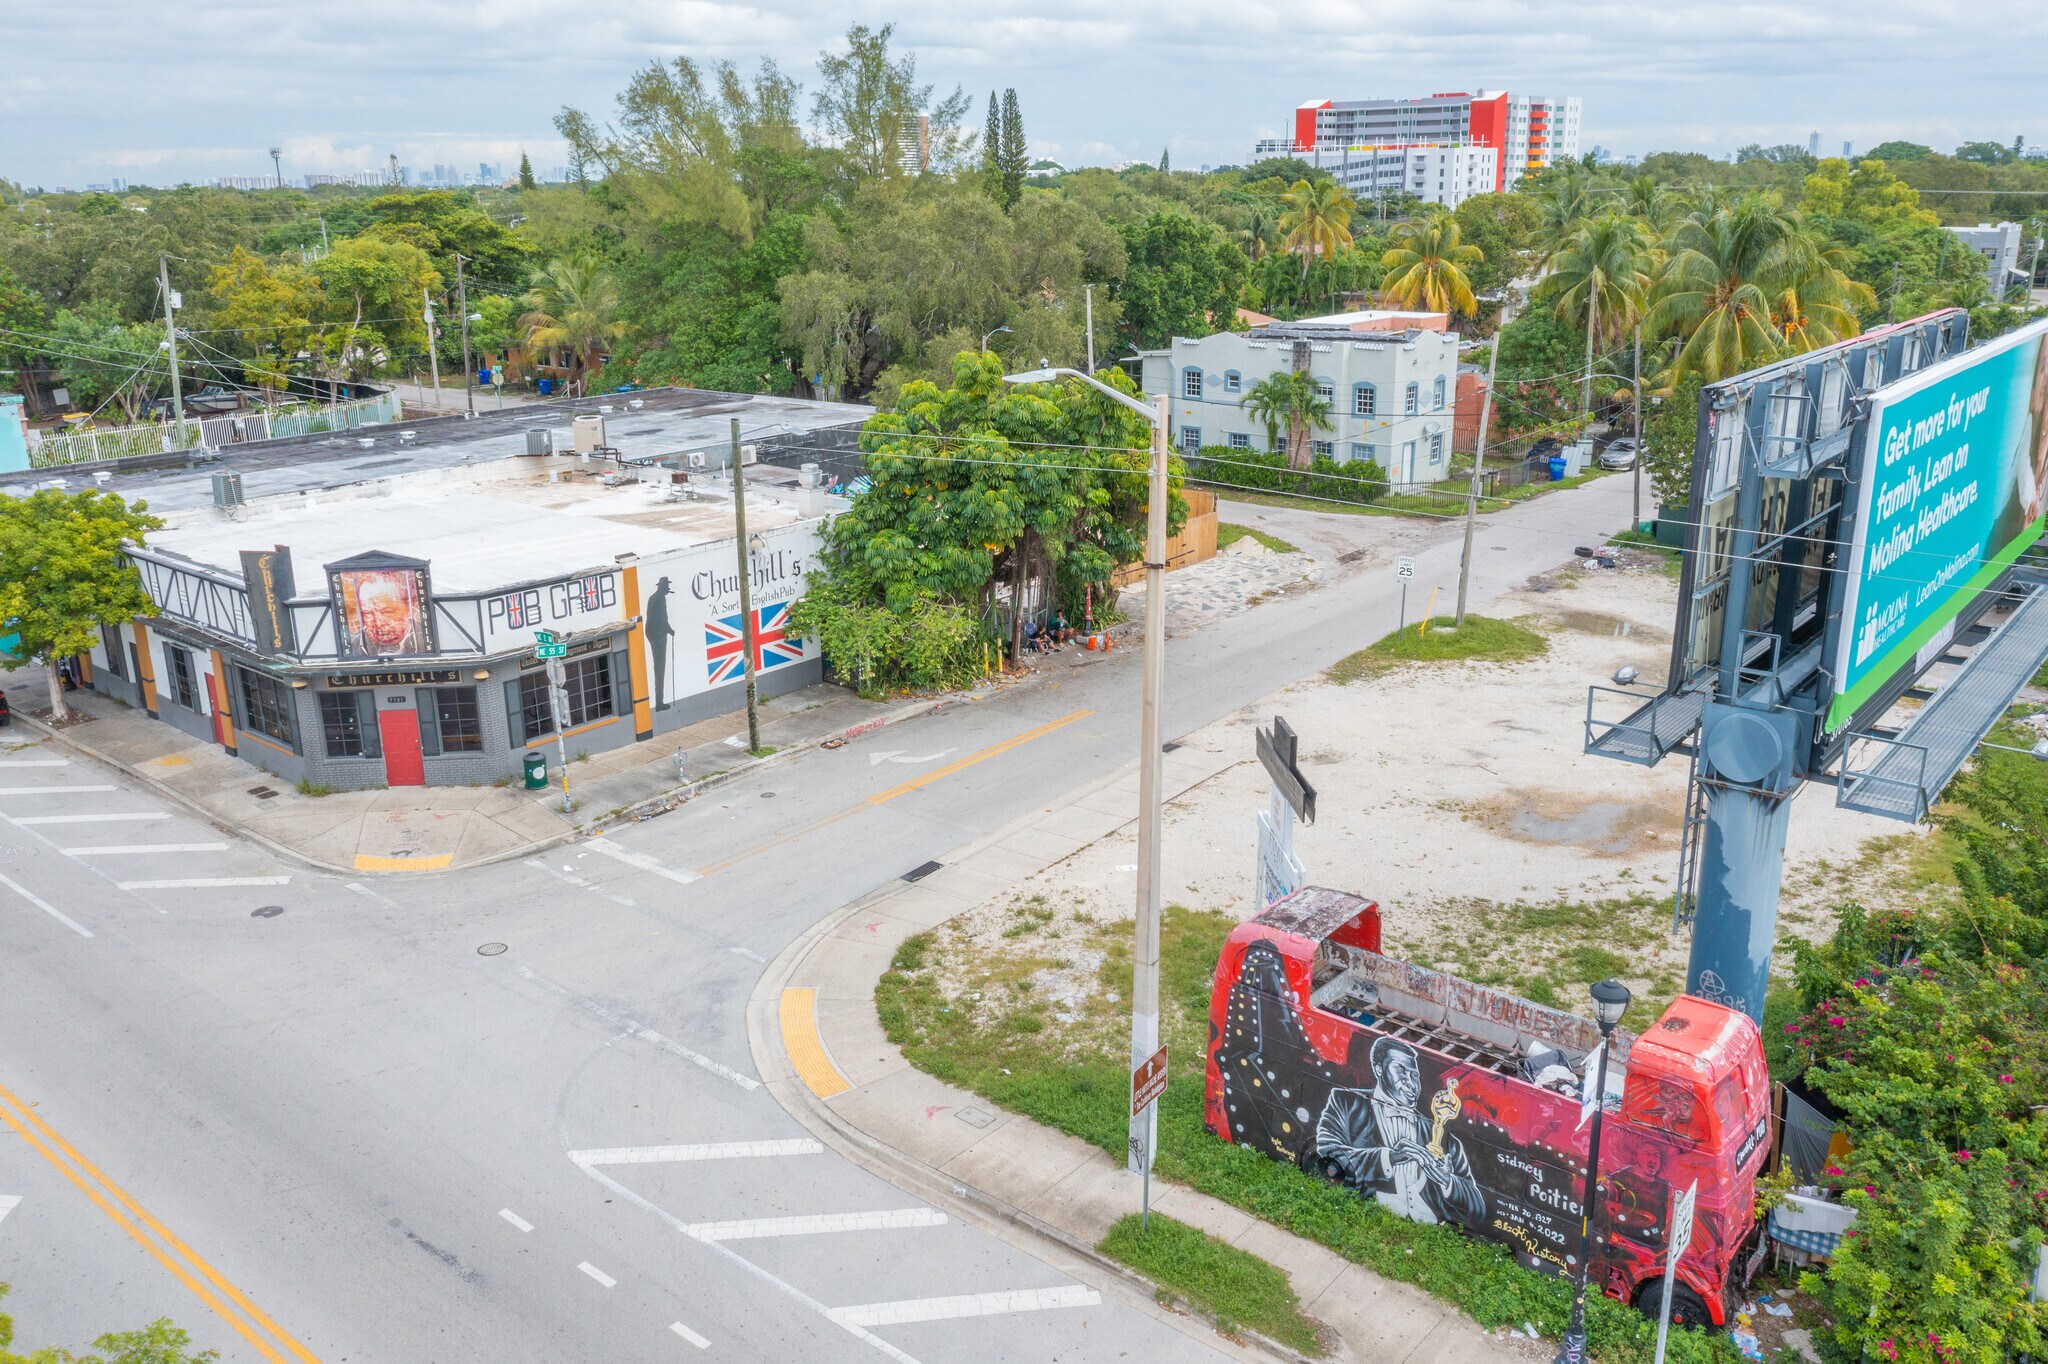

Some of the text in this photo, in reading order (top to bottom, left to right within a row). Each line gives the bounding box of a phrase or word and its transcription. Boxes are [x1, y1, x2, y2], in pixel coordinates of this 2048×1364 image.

[1884, 386, 1991, 467] Get more for your
[1876, 442, 1970, 525] family. Lean on
[1868, 521, 1915, 581] Molina
[1915, 479, 1979, 545] Healthcare.
[691, 549, 802, 602] Churhill's
[1399, 567, 1412, 577] 25
[1915, 542, 1980, 608] LeanOnMolina.com
[487, 573, 616, 635] PUB GRUB
[722, 601, 740, 613] Sort
[751, 588, 779, 606] English
[1877, 591, 1909, 635] MOLINA
[539, 645, 565, 656] NE 55 ST
[331, 670, 456, 686] Churchill's
[1508, 1203, 1520, 1212] FEB
[1493, 1219, 1529, 1241] Black
[1673, 1219, 1691, 1260] 35
